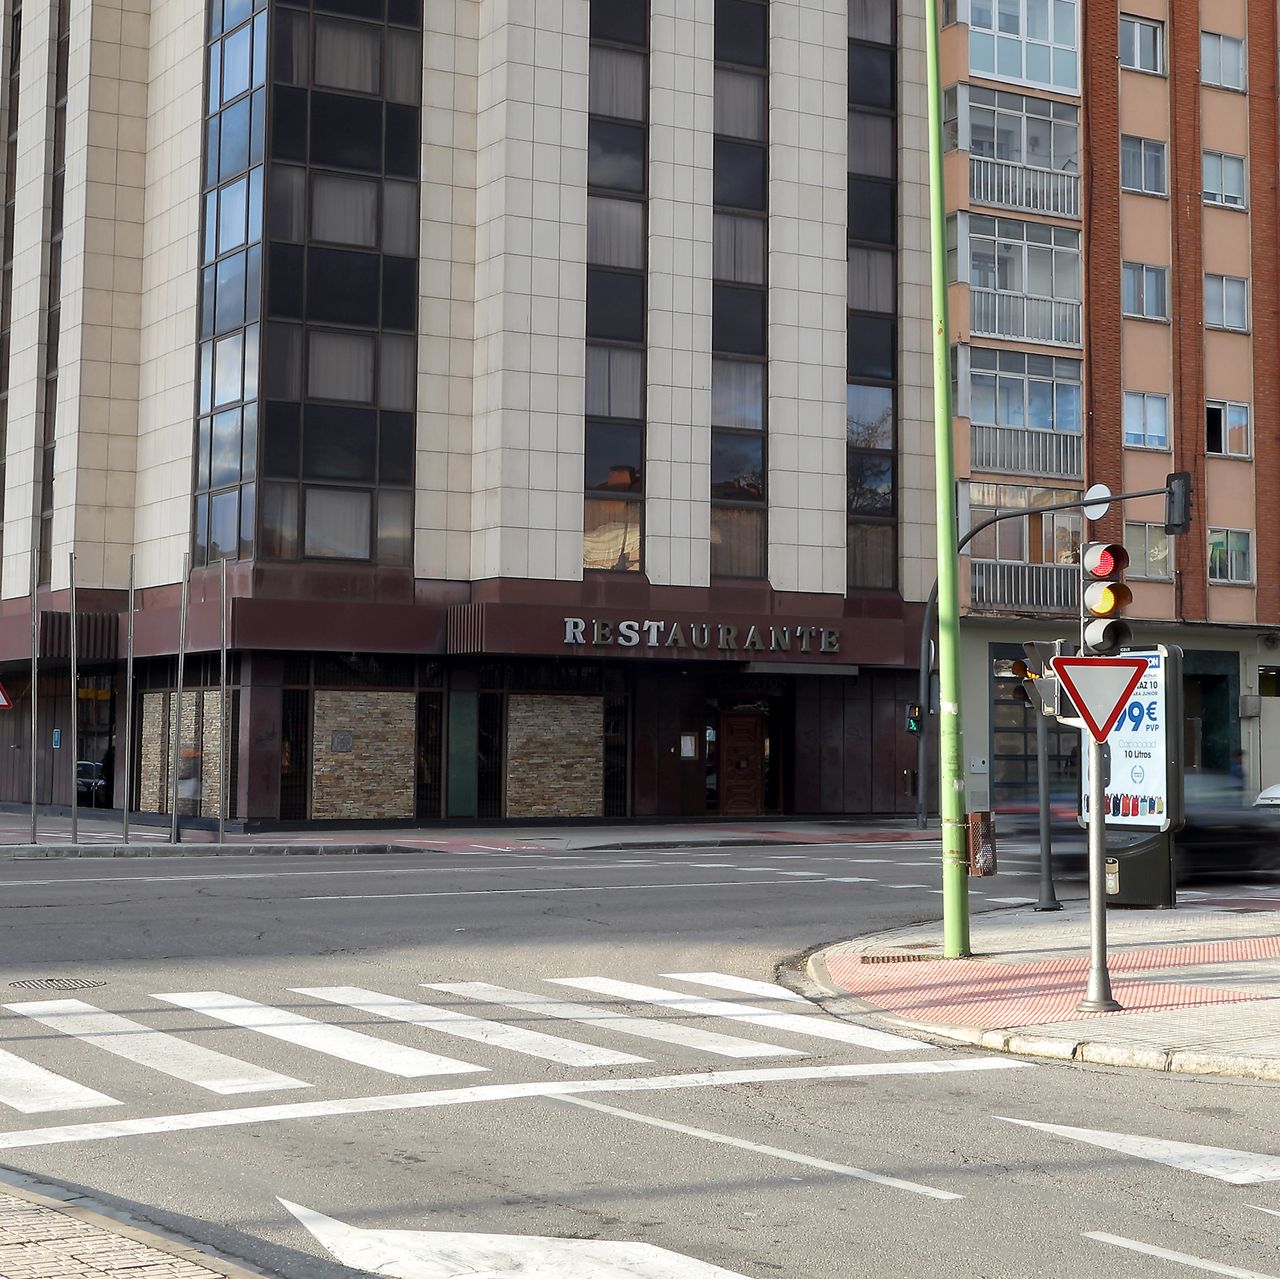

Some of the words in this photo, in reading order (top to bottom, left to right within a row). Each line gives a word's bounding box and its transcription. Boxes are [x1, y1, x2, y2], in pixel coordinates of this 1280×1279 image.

[563, 616, 841, 653] RESTAURANTE
[1149, 681, 1158, 689] 10
[1145, 724, 1160, 732] PVP
[1124, 750, 1133, 759] 10
[1134, 750, 1152, 759] Litros
